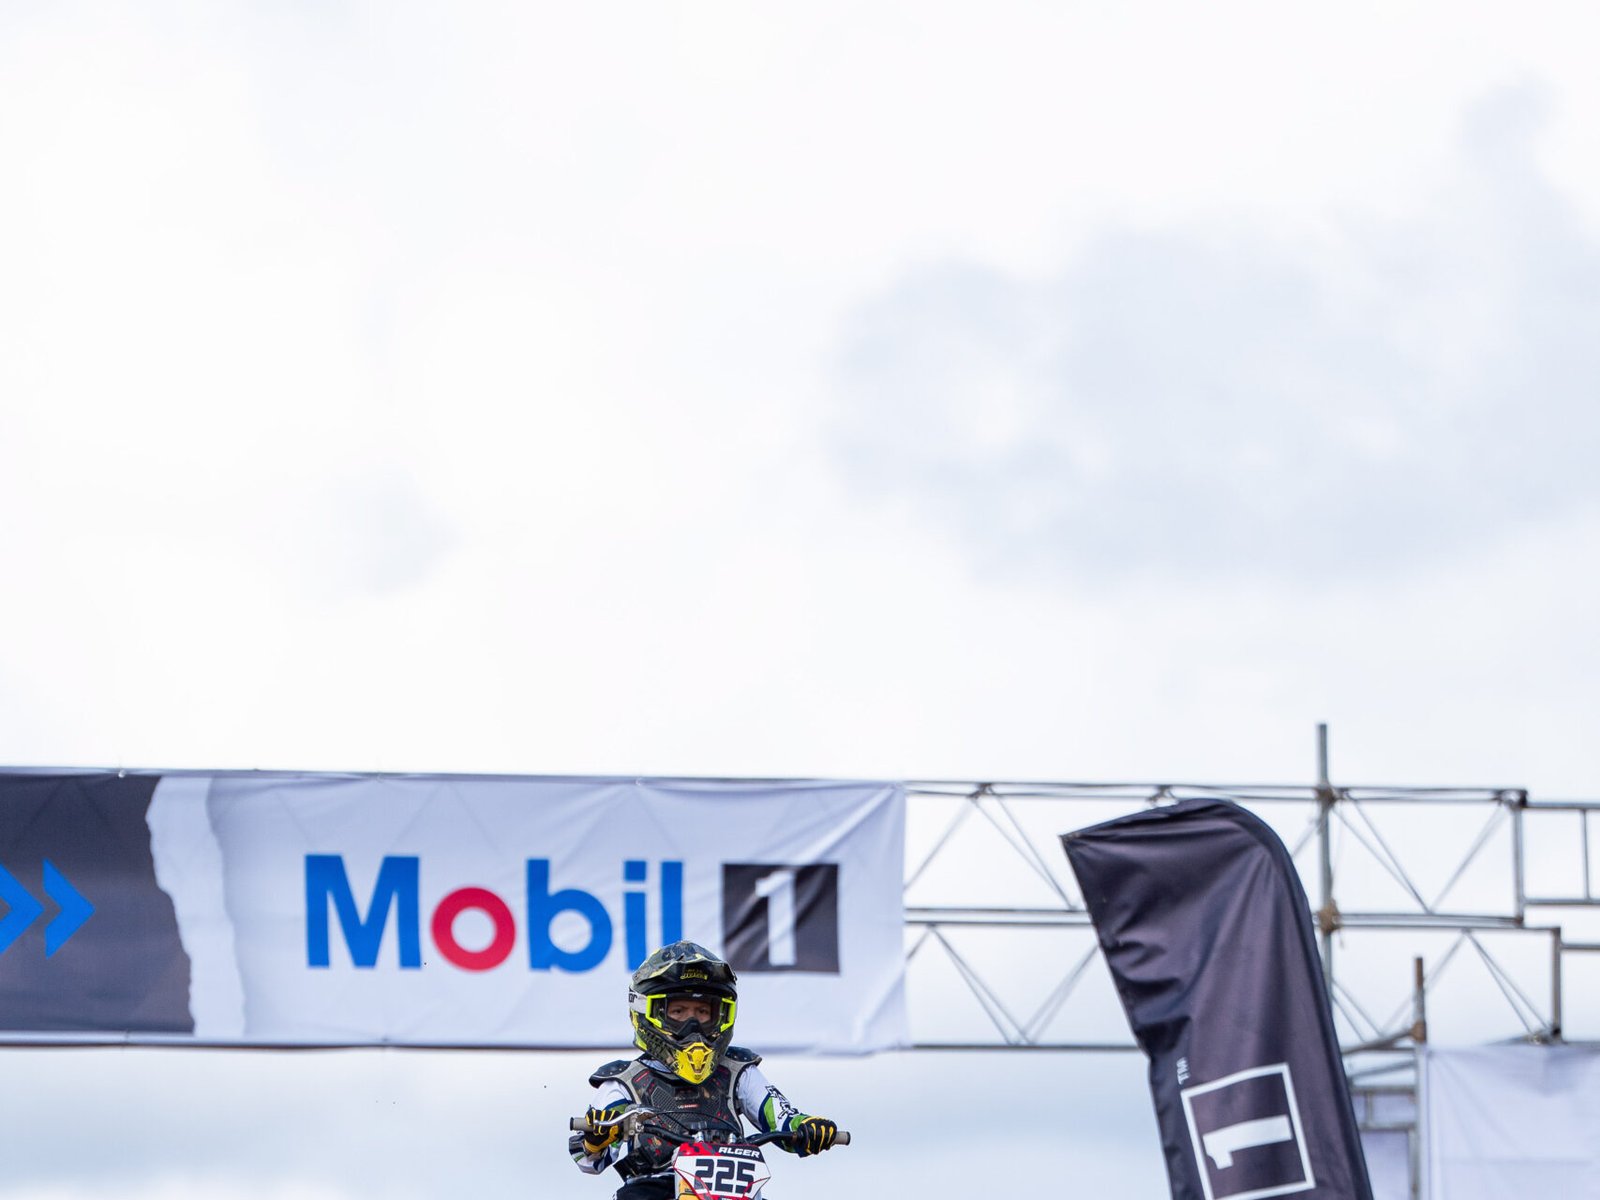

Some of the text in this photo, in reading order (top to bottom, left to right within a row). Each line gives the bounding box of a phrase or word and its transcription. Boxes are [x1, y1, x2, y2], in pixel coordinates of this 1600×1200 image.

[304, 854, 797, 972] Mobil 1
[718, 1146, 760, 1158] ALGER
[1202, 1114, 1293, 1170] 1
[694, 1158, 756, 1194] 225
